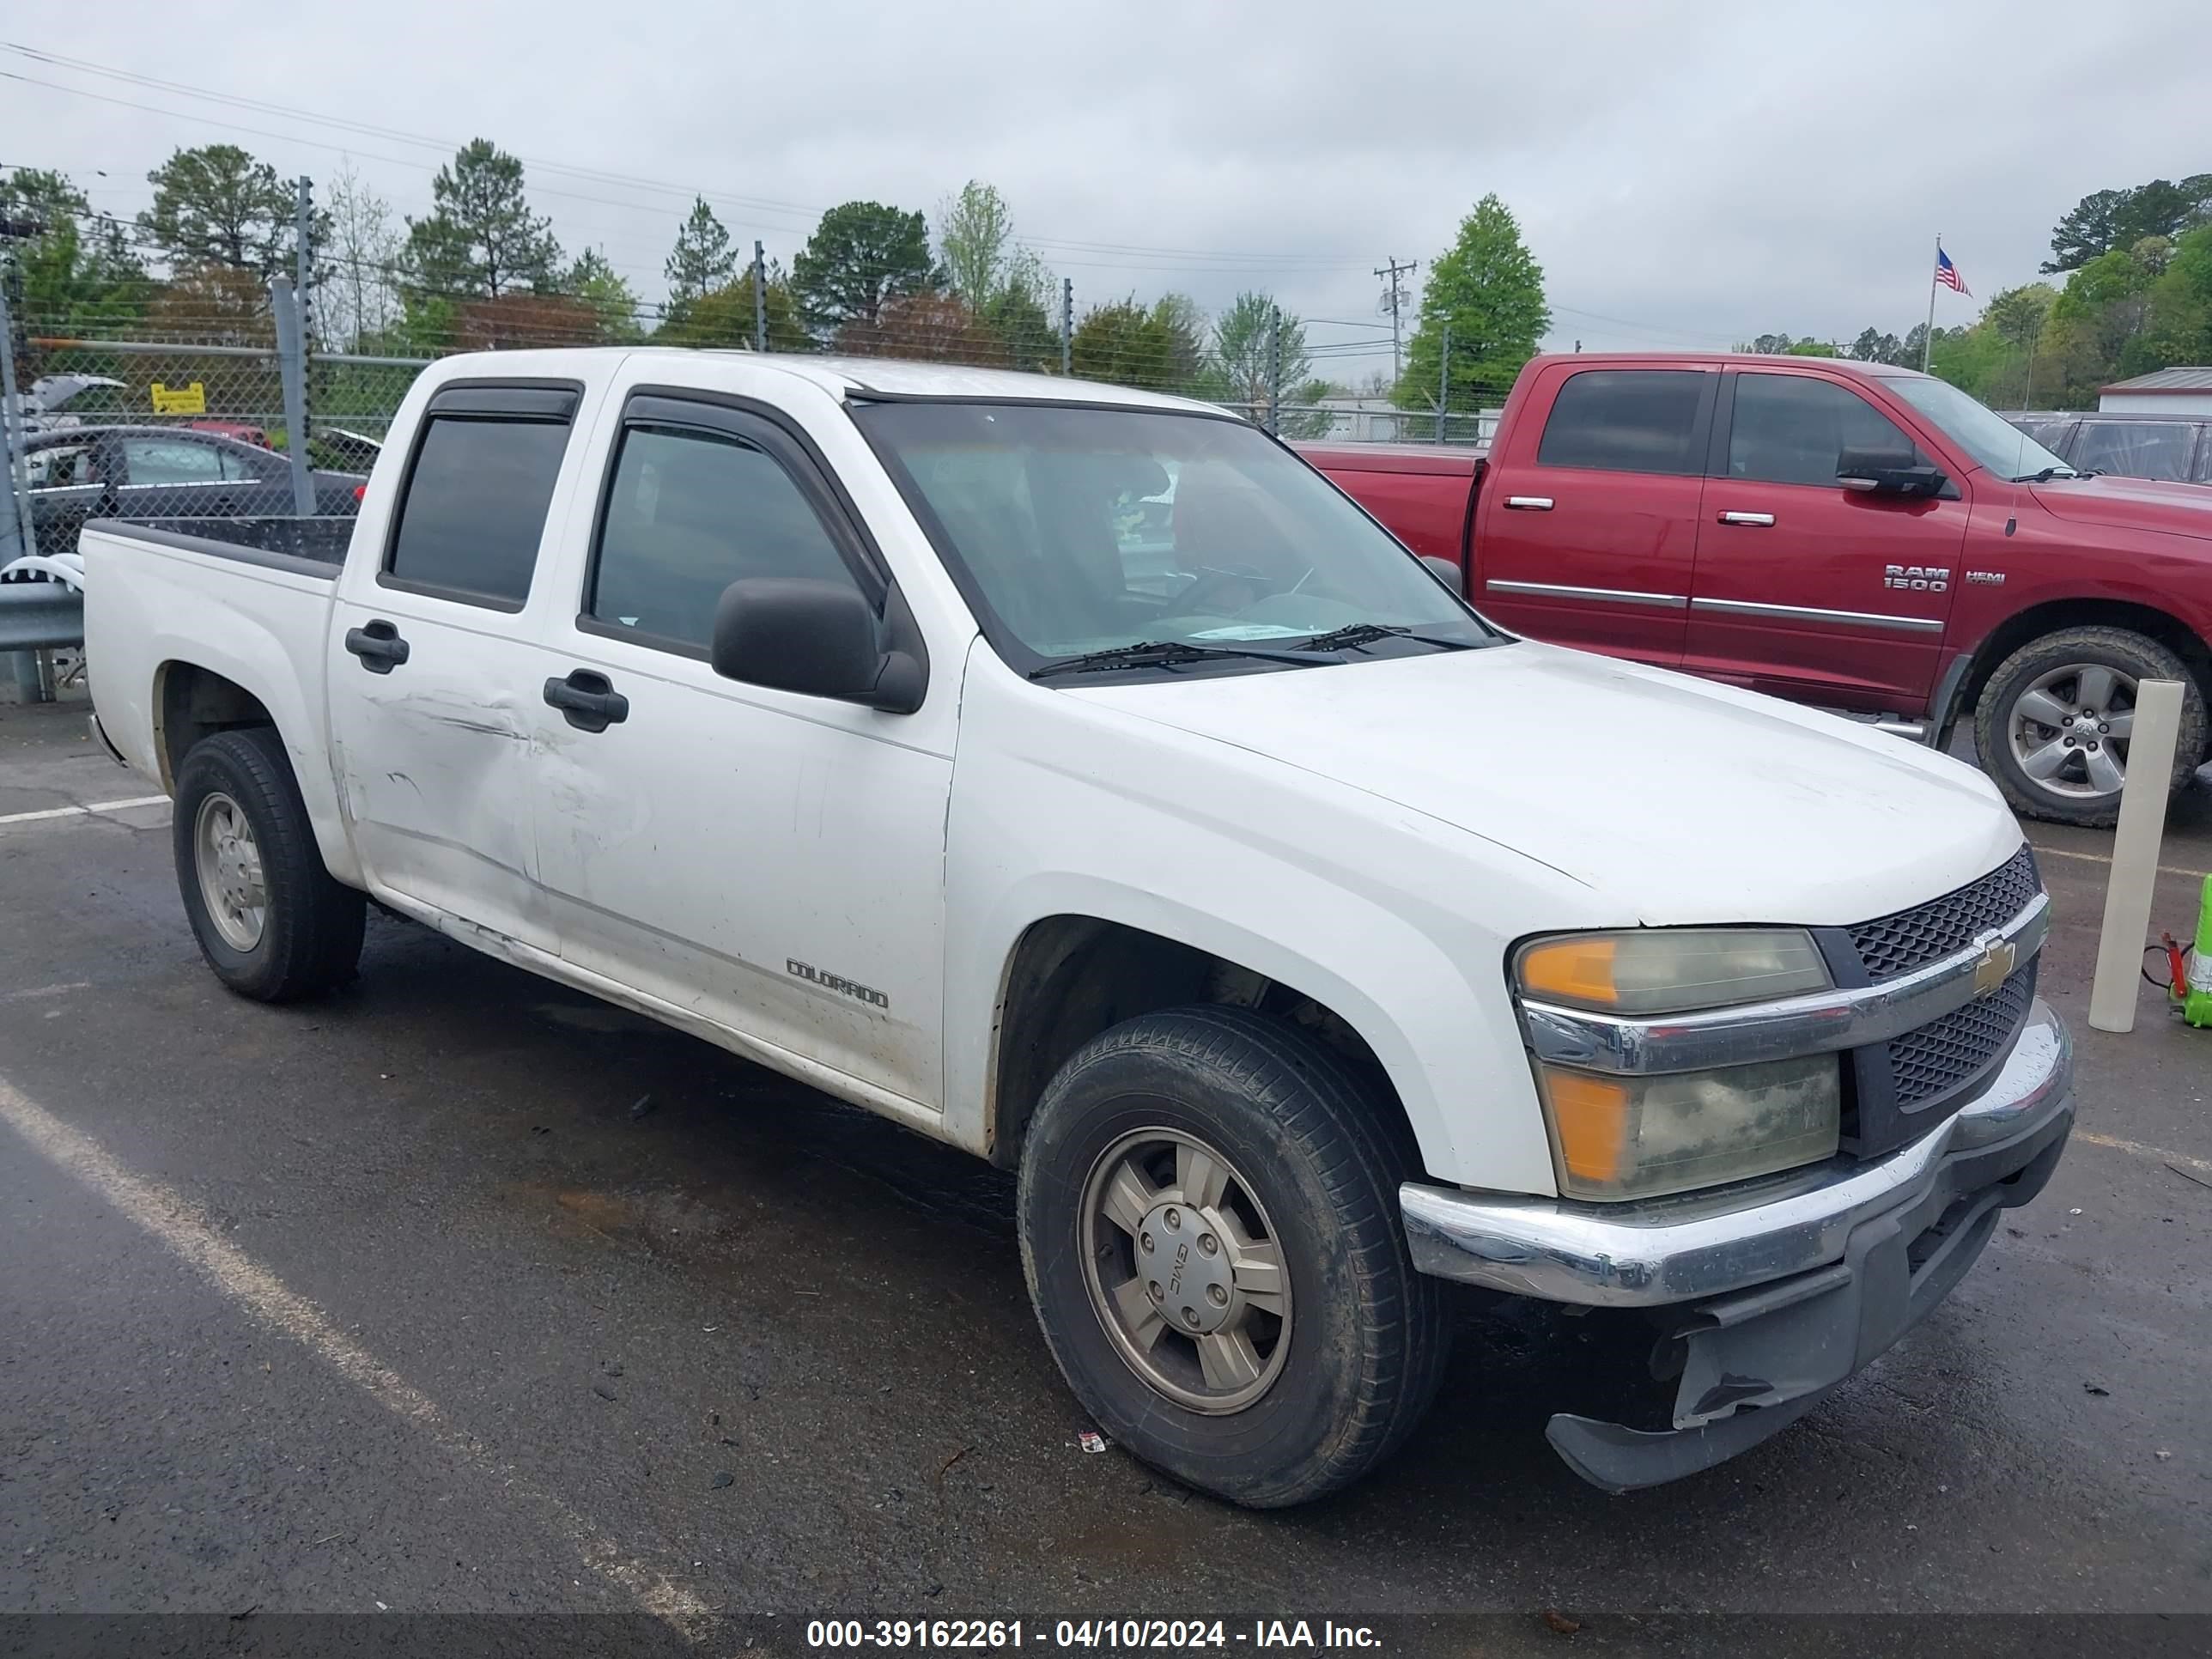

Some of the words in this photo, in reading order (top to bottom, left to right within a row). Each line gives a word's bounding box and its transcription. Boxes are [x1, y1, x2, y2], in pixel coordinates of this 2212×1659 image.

[1885, 564, 1950, 580] RAM
[1966, 570, 2006, 582] HEMI
[1883, 577, 1948, 592] 1500
[786, 957, 889, 1008] COLORADO
[1170, 1243, 1188, 1296] GMC
